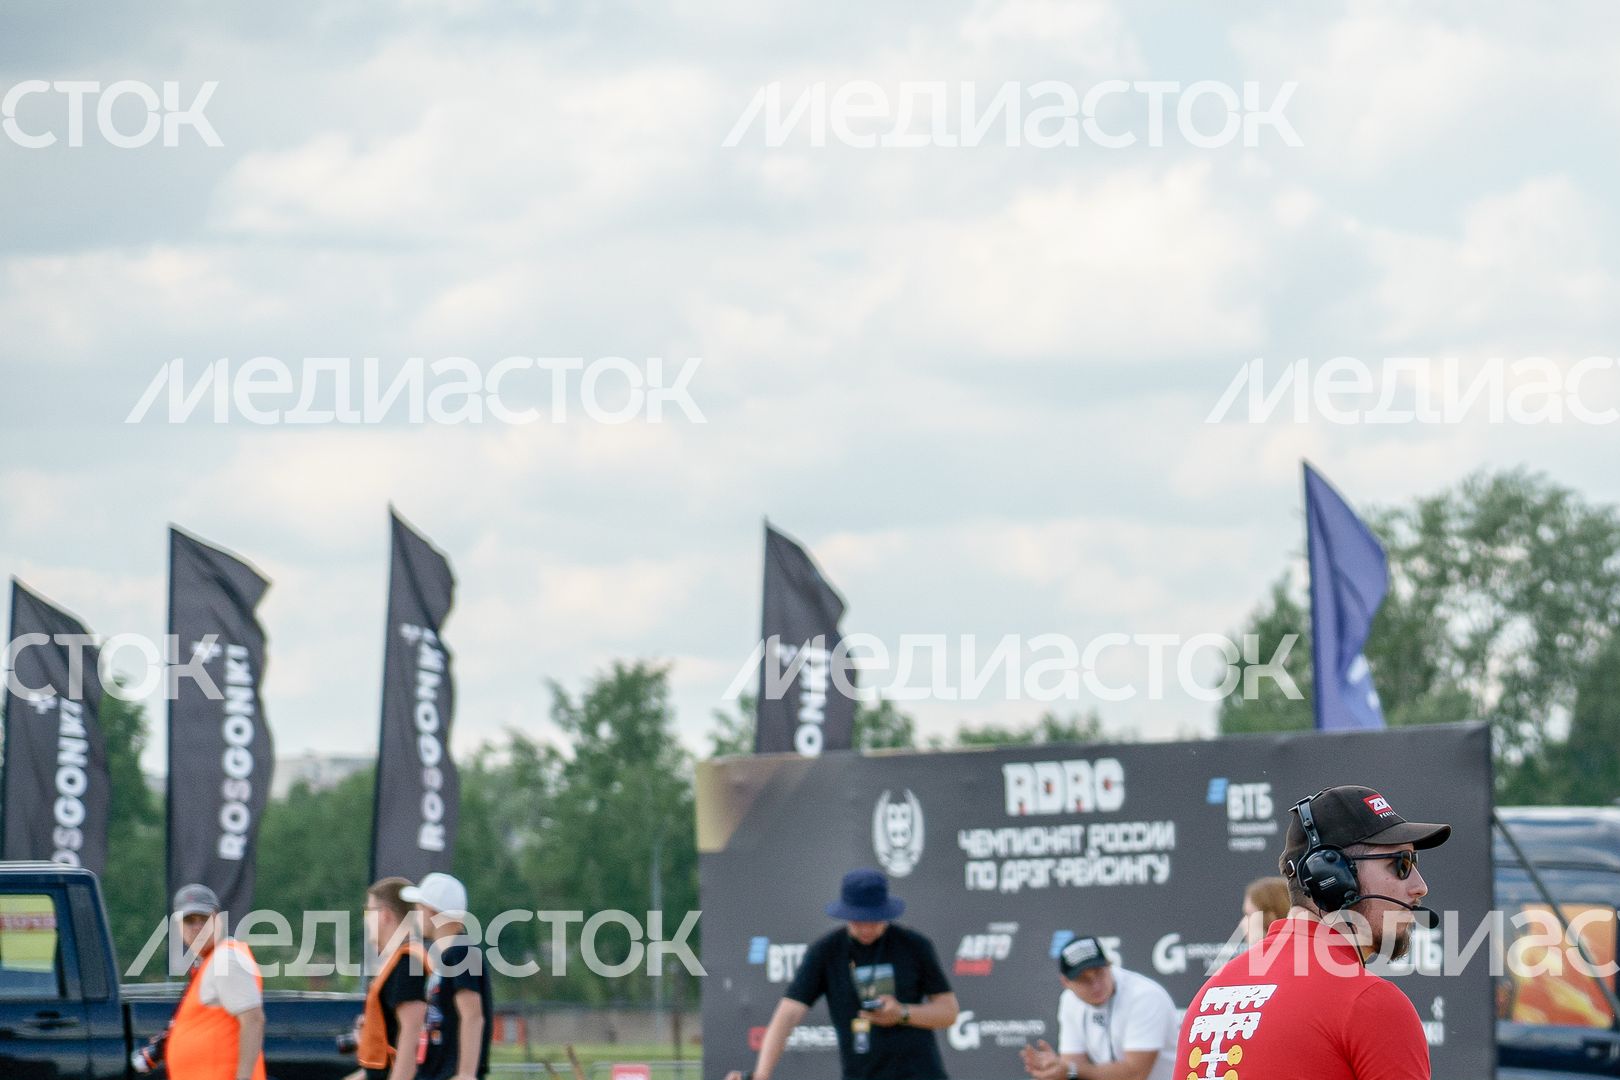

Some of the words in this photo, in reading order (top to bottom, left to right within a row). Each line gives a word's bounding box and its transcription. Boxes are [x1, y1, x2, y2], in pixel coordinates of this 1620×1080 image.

[216, 642, 255, 861] ROSGONKI
[51, 697, 89, 868] OSGONKI
[1002, 757, 1126, 817] RDRC
[1226, 781, 1274, 821] ВТБ
[957, 824, 1084, 858] ЧЕМПИОНАТ
[1087, 819, 1176, 852] РОССИИ
[964, 859, 998, 891] ПО
[767, 943, 808, 983] ВТ
